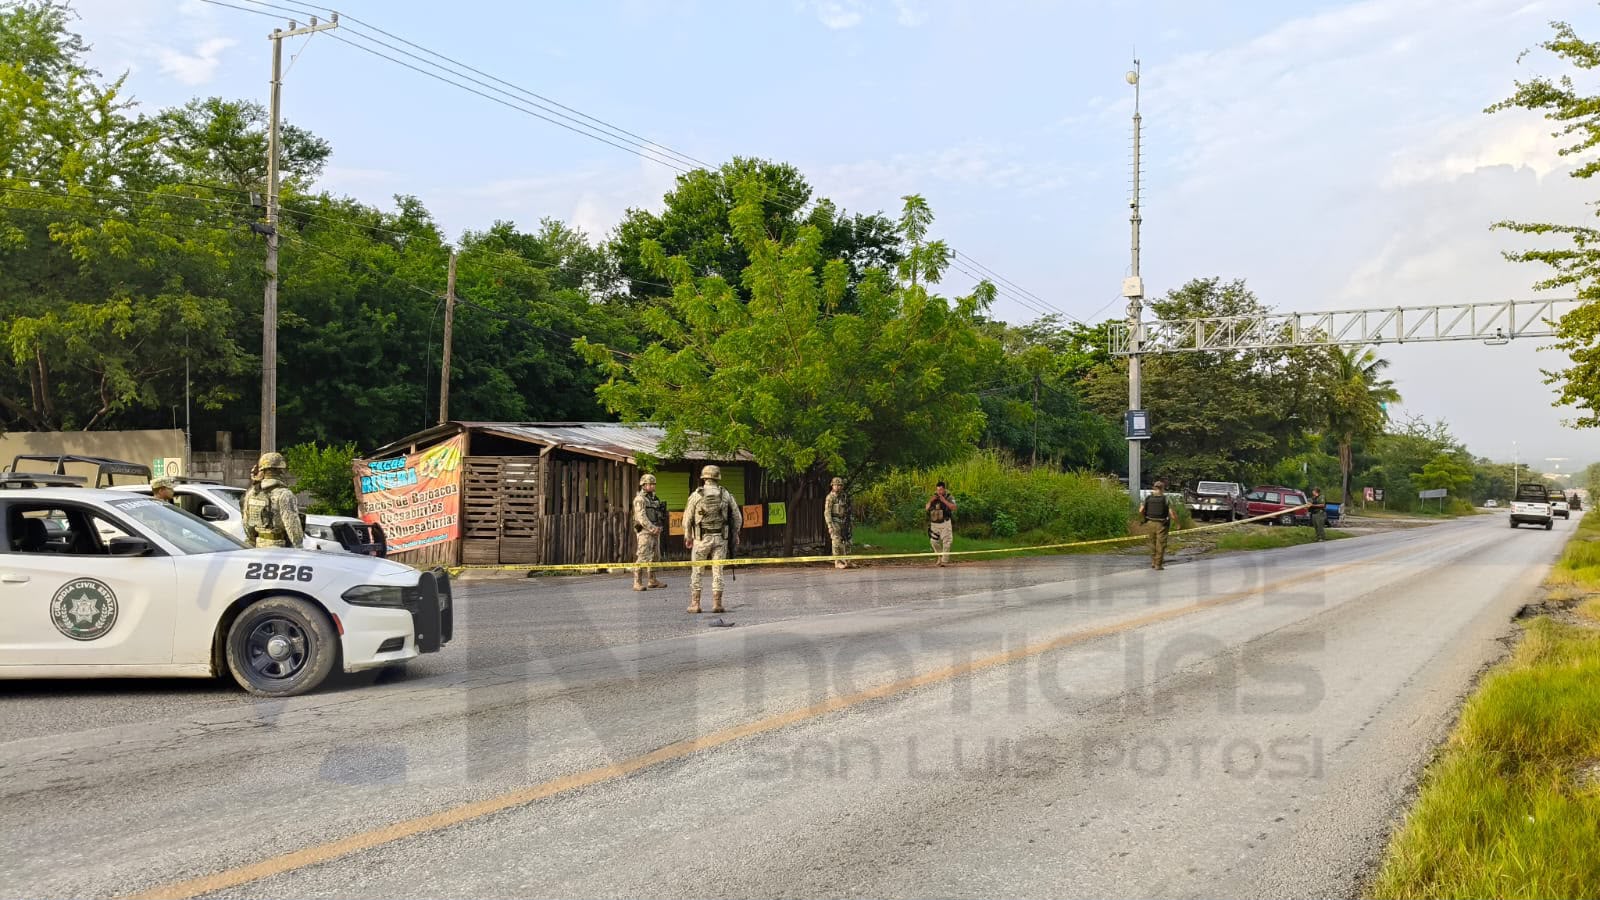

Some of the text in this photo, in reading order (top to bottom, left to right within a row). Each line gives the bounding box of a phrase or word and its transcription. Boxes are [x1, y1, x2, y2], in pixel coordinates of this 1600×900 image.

[367, 456, 407, 471] TACOS
[361, 467, 418, 494] RIVERA
[363, 484, 457, 513] Tacos de Barbacoa
[379, 502, 443, 524] Quesabirrias
[245, 563, 314, 582] 2826
[54, 582, 114, 617] GUARDIA CIVIL ESTATAL
